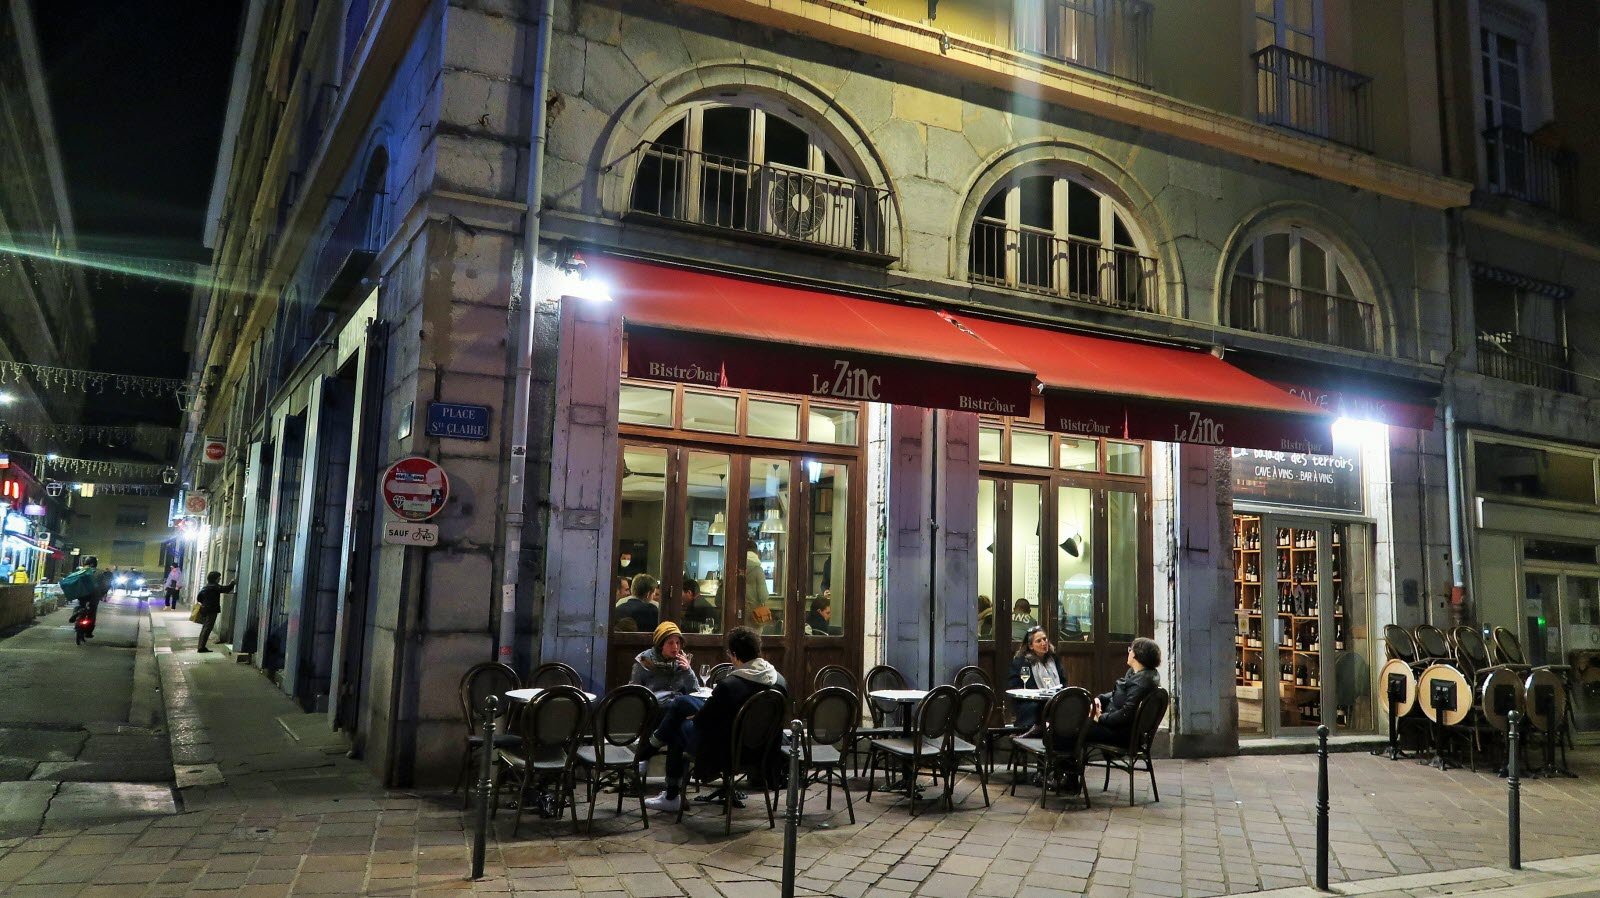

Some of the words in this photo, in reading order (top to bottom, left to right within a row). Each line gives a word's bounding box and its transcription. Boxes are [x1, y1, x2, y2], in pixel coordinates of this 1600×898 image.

[812, 373, 830, 394] Le
[831, 359, 881, 400] Zinc
[442, 407, 475, 420] PLACE
[446, 423, 484, 436] CLAIRE
[1173, 423, 1187, 442] Le
[1188, 411, 1225, 444] Zinc
[1290, 453, 1307, 466] des
[1312, 456, 1353, 471] terroirs
[1255, 466, 1271, 477] CAVE
[1278, 469, 1293, 480] VINS
[1300, 471, 1312, 482] BAR
[1318, 473, 1333, 484] VINS
[388, 529, 409, 537] SAUF
